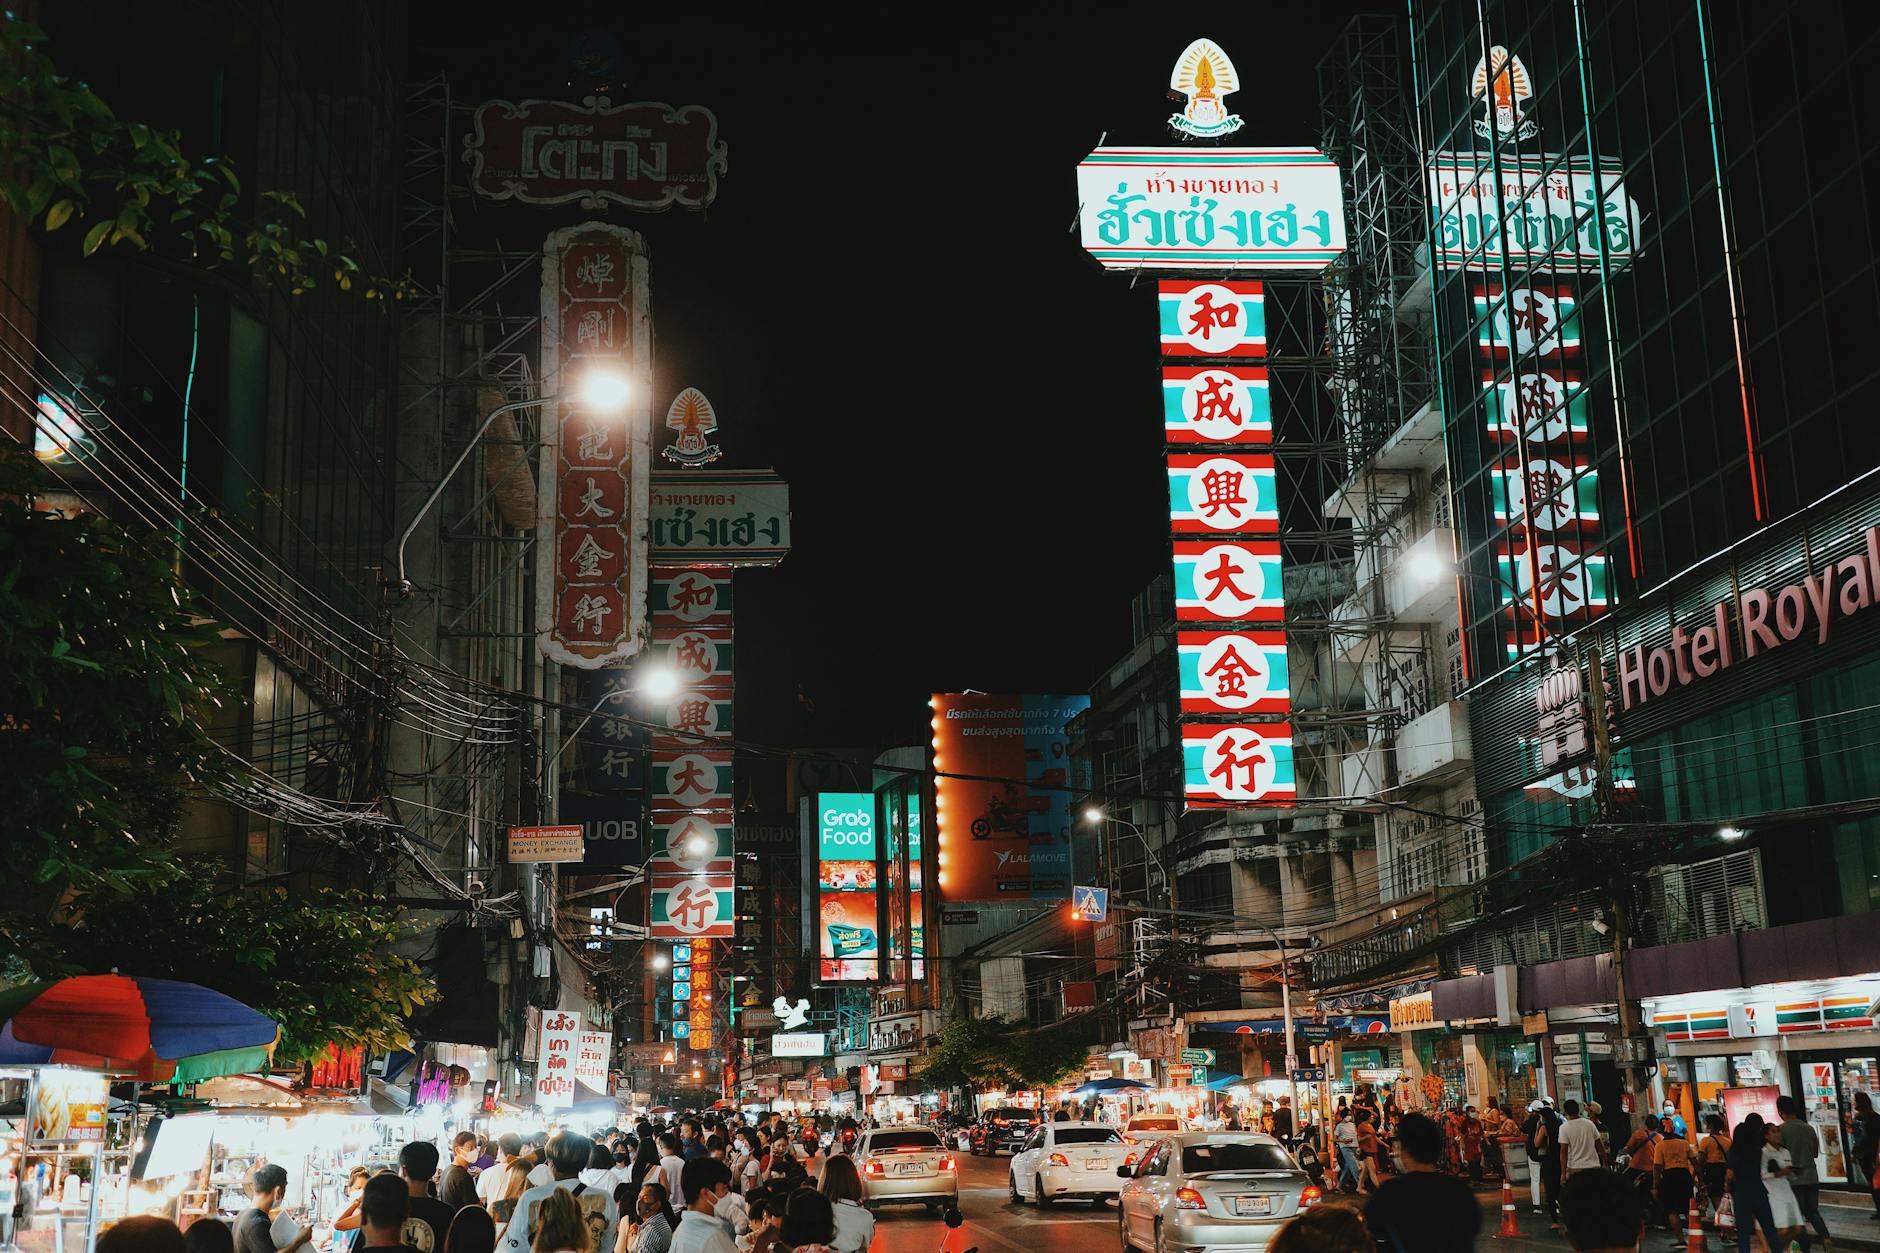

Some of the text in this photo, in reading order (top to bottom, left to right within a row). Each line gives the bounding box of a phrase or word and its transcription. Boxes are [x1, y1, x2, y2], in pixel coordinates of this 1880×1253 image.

[1146, 169, 1279, 194] ห้างขายทอง
[1096, 181, 1331, 248] ฮั่วเซ่งเฮง
[652, 506, 780, 547] เซ่งเฮง
[1187, 291, 1266, 794] 和成興大金行
[1619, 527, 1880, 711] Hotel Royal
[669, 577, 715, 928] 和成興大金行
[586, 821, 638, 841] UOB
[823, 809, 870, 827] Grab
[823, 828, 872, 845] Food
[1010, 853, 1067, 863] LALAMOVE
